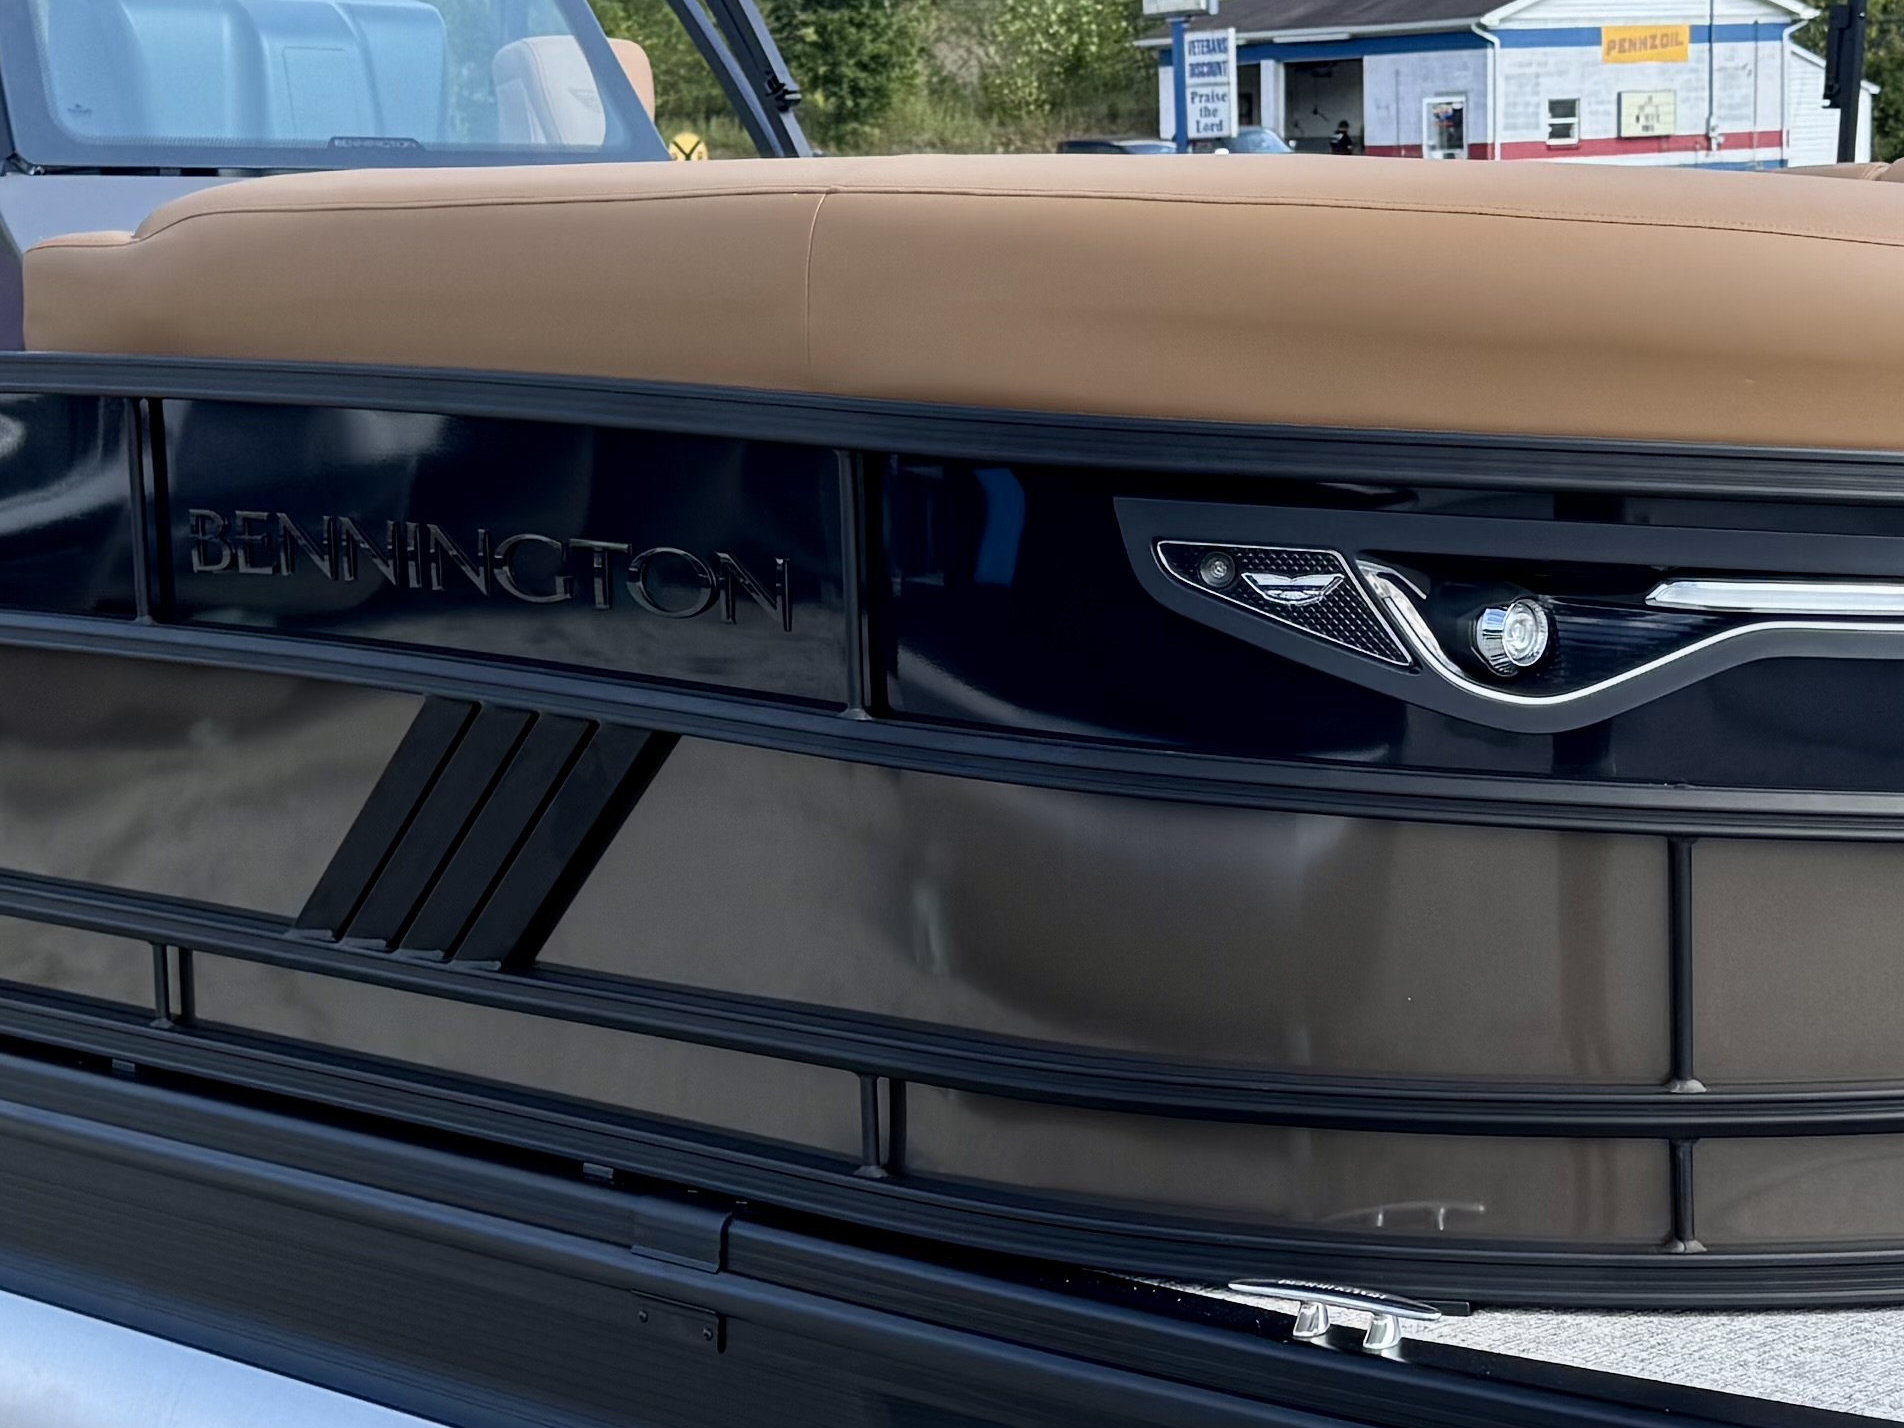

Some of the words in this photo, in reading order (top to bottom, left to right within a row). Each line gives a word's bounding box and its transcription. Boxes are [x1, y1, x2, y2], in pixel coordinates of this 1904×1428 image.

[1188, 37, 1229, 56] VETERANS
[1606, 32, 1684, 56] PENNZOIL
[1190, 91, 1228, 104] Praise
[1199, 106, 1218, 118] the
[1196, 119, 1223, 133] Lord
[189, 509, 793, 632] BENNINGTON
